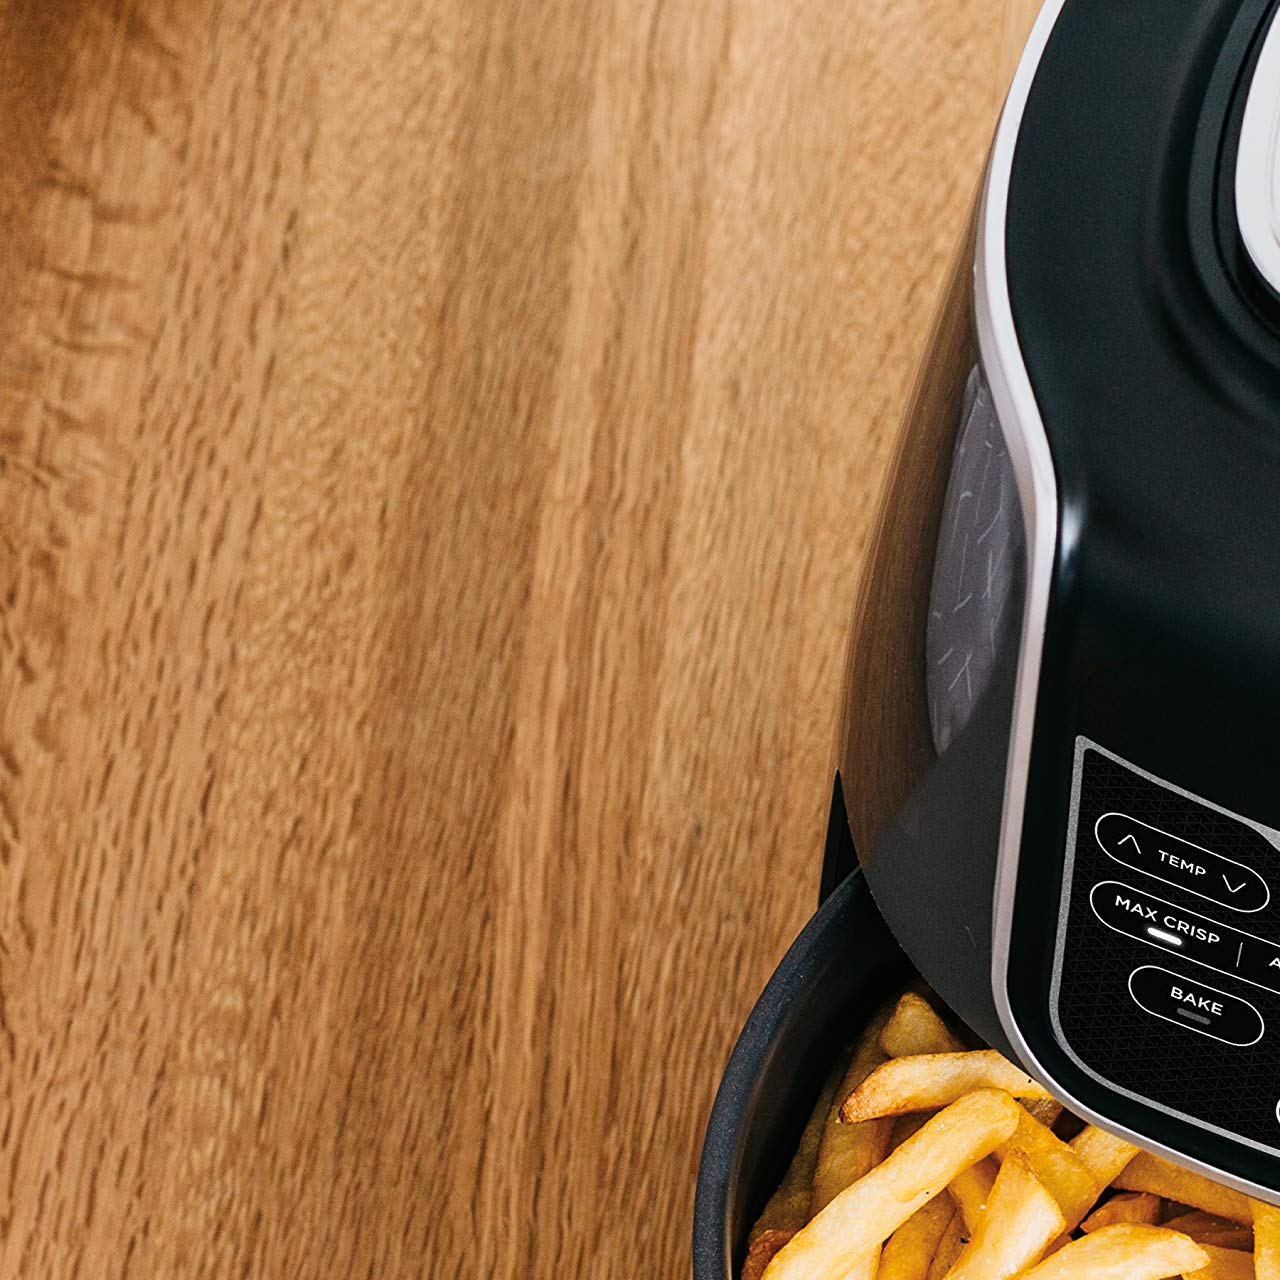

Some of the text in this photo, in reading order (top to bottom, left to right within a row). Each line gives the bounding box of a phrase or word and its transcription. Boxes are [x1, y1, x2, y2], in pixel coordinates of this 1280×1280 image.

[1158, 849, 1207, 876] TEMP
[1115, 895, 1220, 944] MAX CRISP
[1170, 986, 1224, 1016] BAKE
